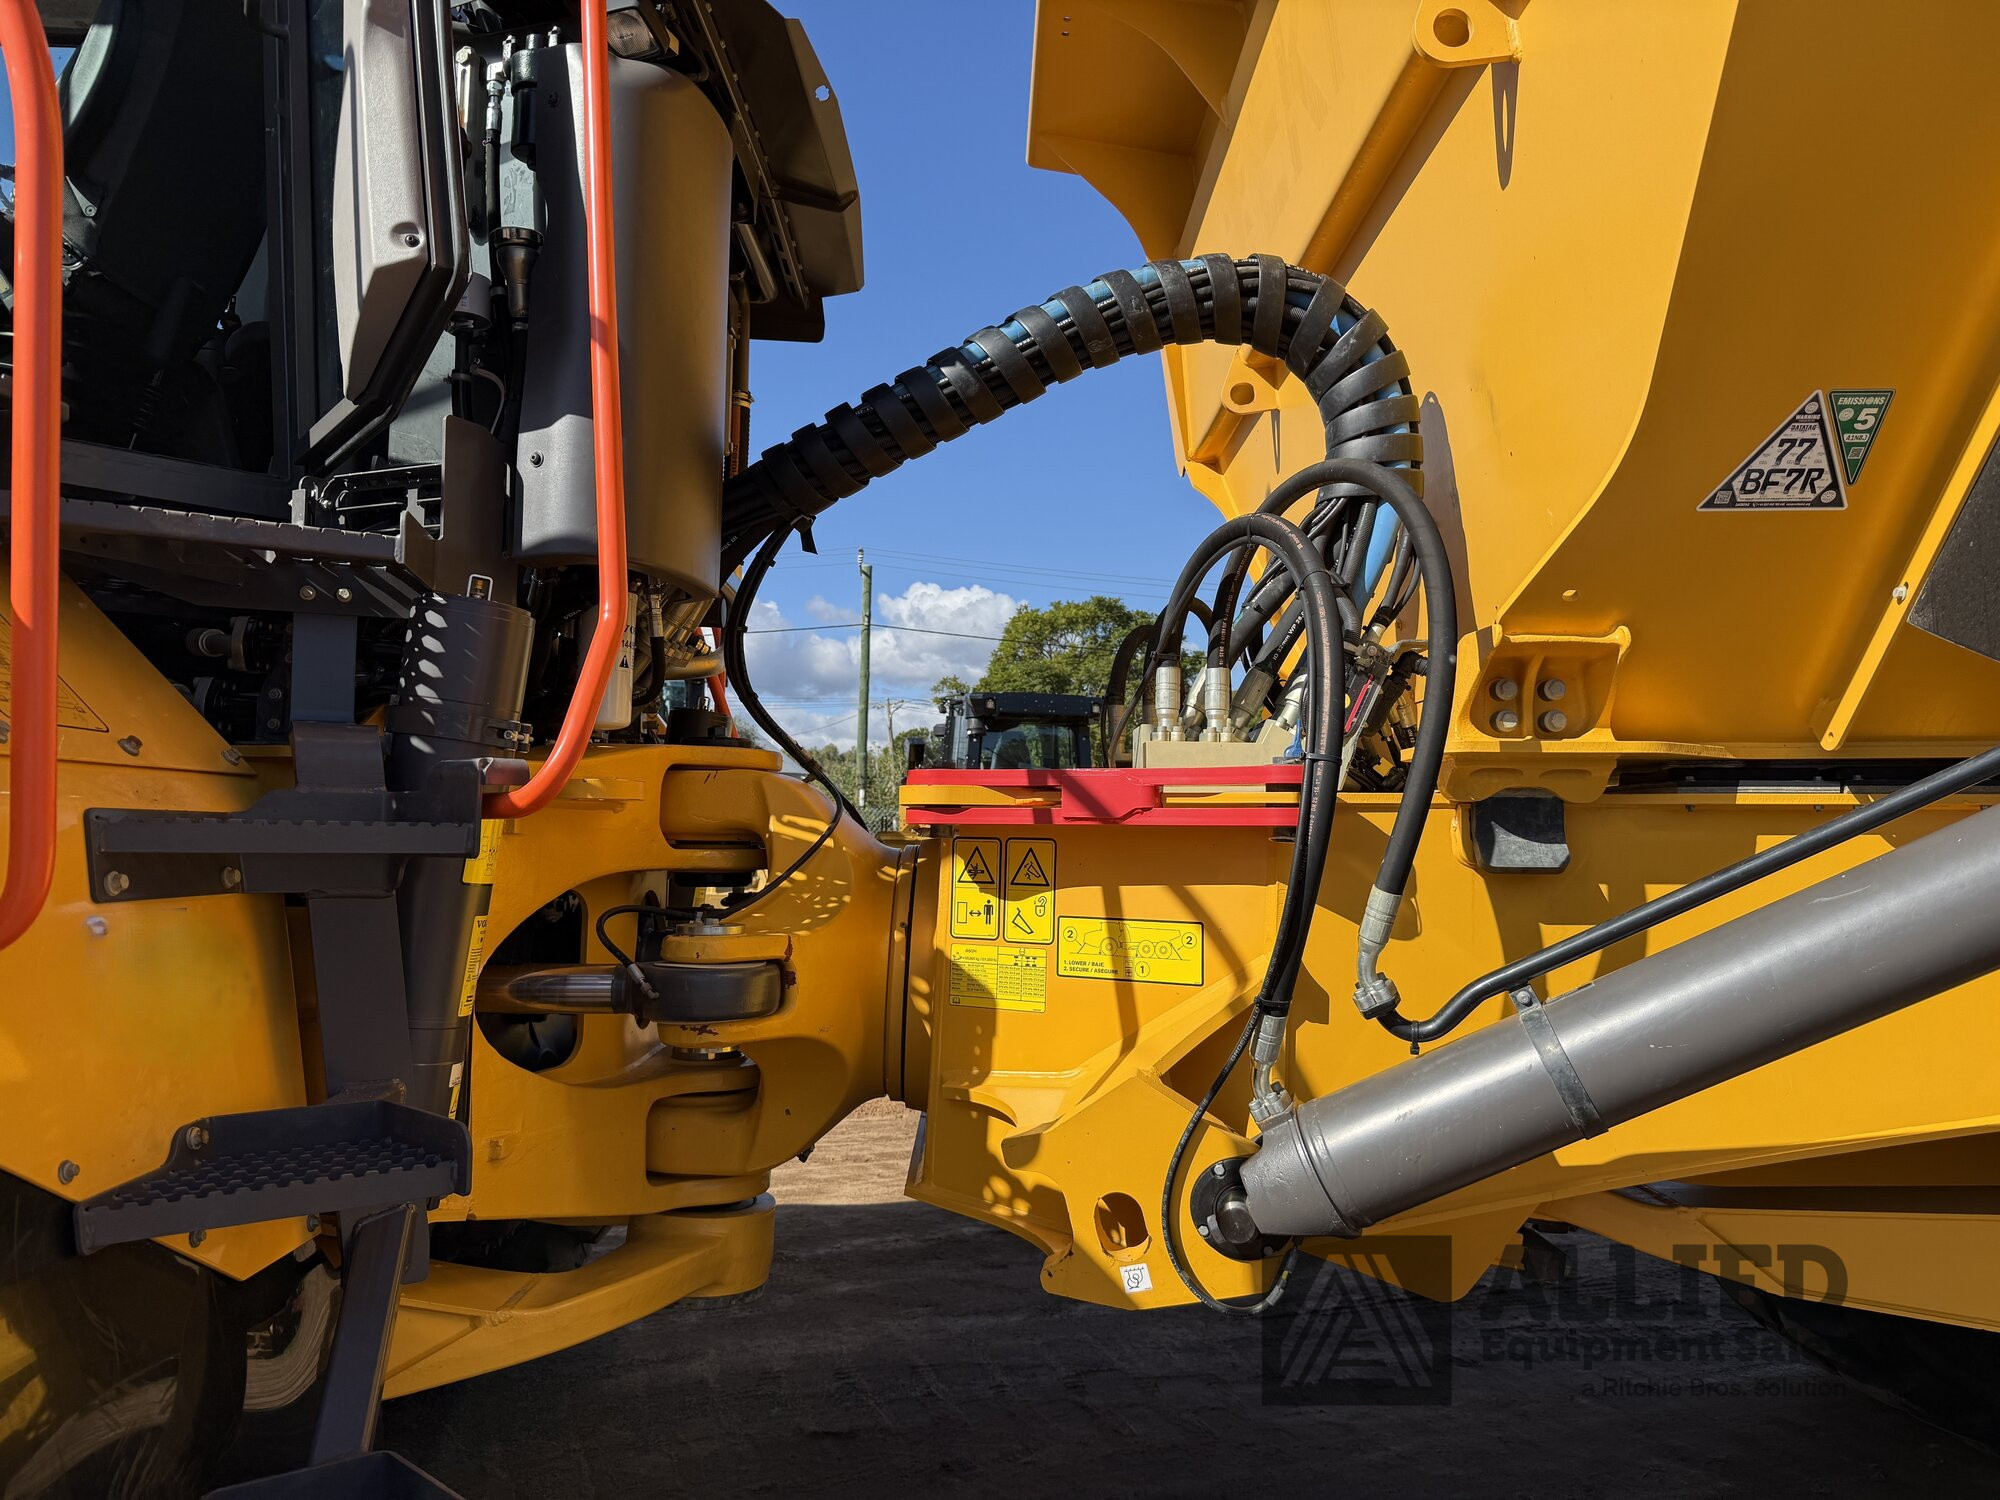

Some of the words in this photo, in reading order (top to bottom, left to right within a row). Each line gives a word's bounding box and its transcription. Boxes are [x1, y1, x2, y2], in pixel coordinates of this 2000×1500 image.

[1853, 407, 1879, 431] 5
[1776, 438, 1817, 465] 77
[1740, 468, 1825, 495] BF7R
[1067, 929, 1074, 939] 2
[1185, 935, 1193, 945] 2
[1094, 967, 1119, 975] ASEGURE
[1140, 965, 1145, 974] 1
